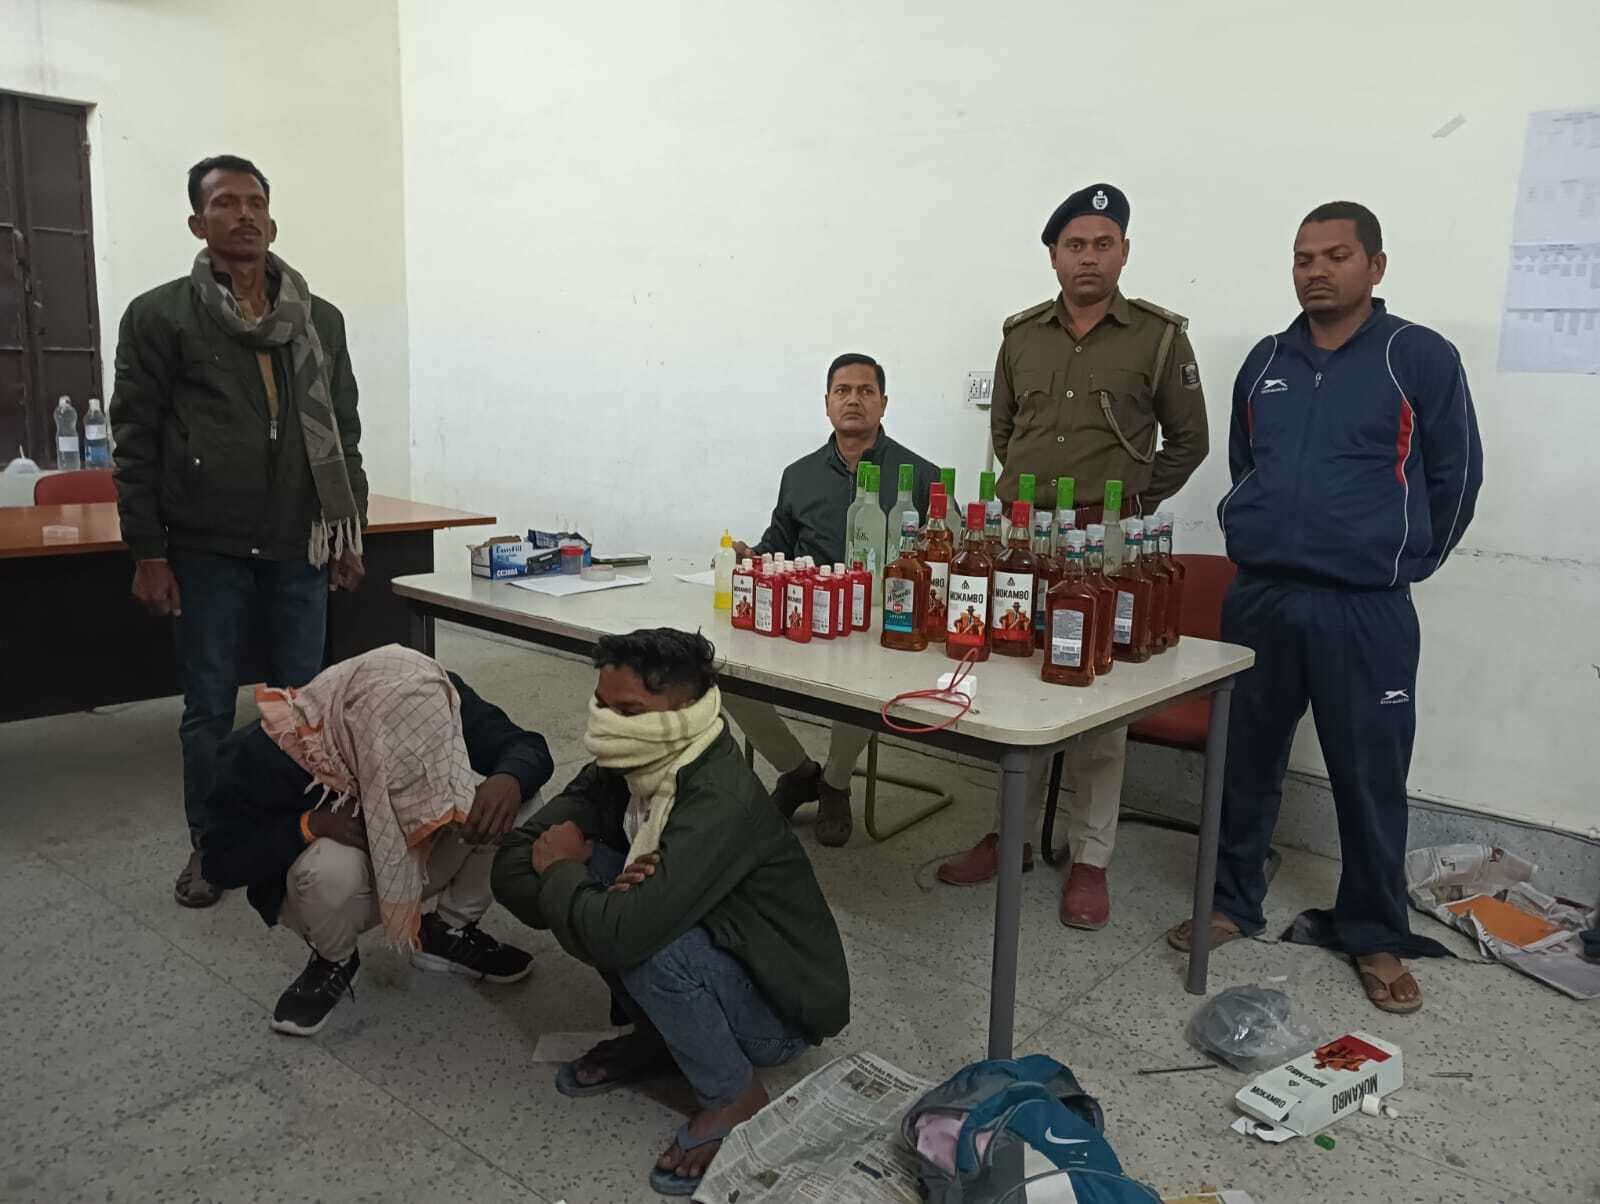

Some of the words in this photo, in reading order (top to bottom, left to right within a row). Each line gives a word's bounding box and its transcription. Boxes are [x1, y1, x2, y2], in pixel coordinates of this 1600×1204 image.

[949, 591, 984, 604] MOKAMBO
[995, 588, 1029, 600] MOKAMBO
[1284, 1064, 1328, 1088] MOKAMBO
[1250, 1085, 1287, 1109] MOKAMBO
[1331, 1072, 1378, 1115] MOKAMBO
